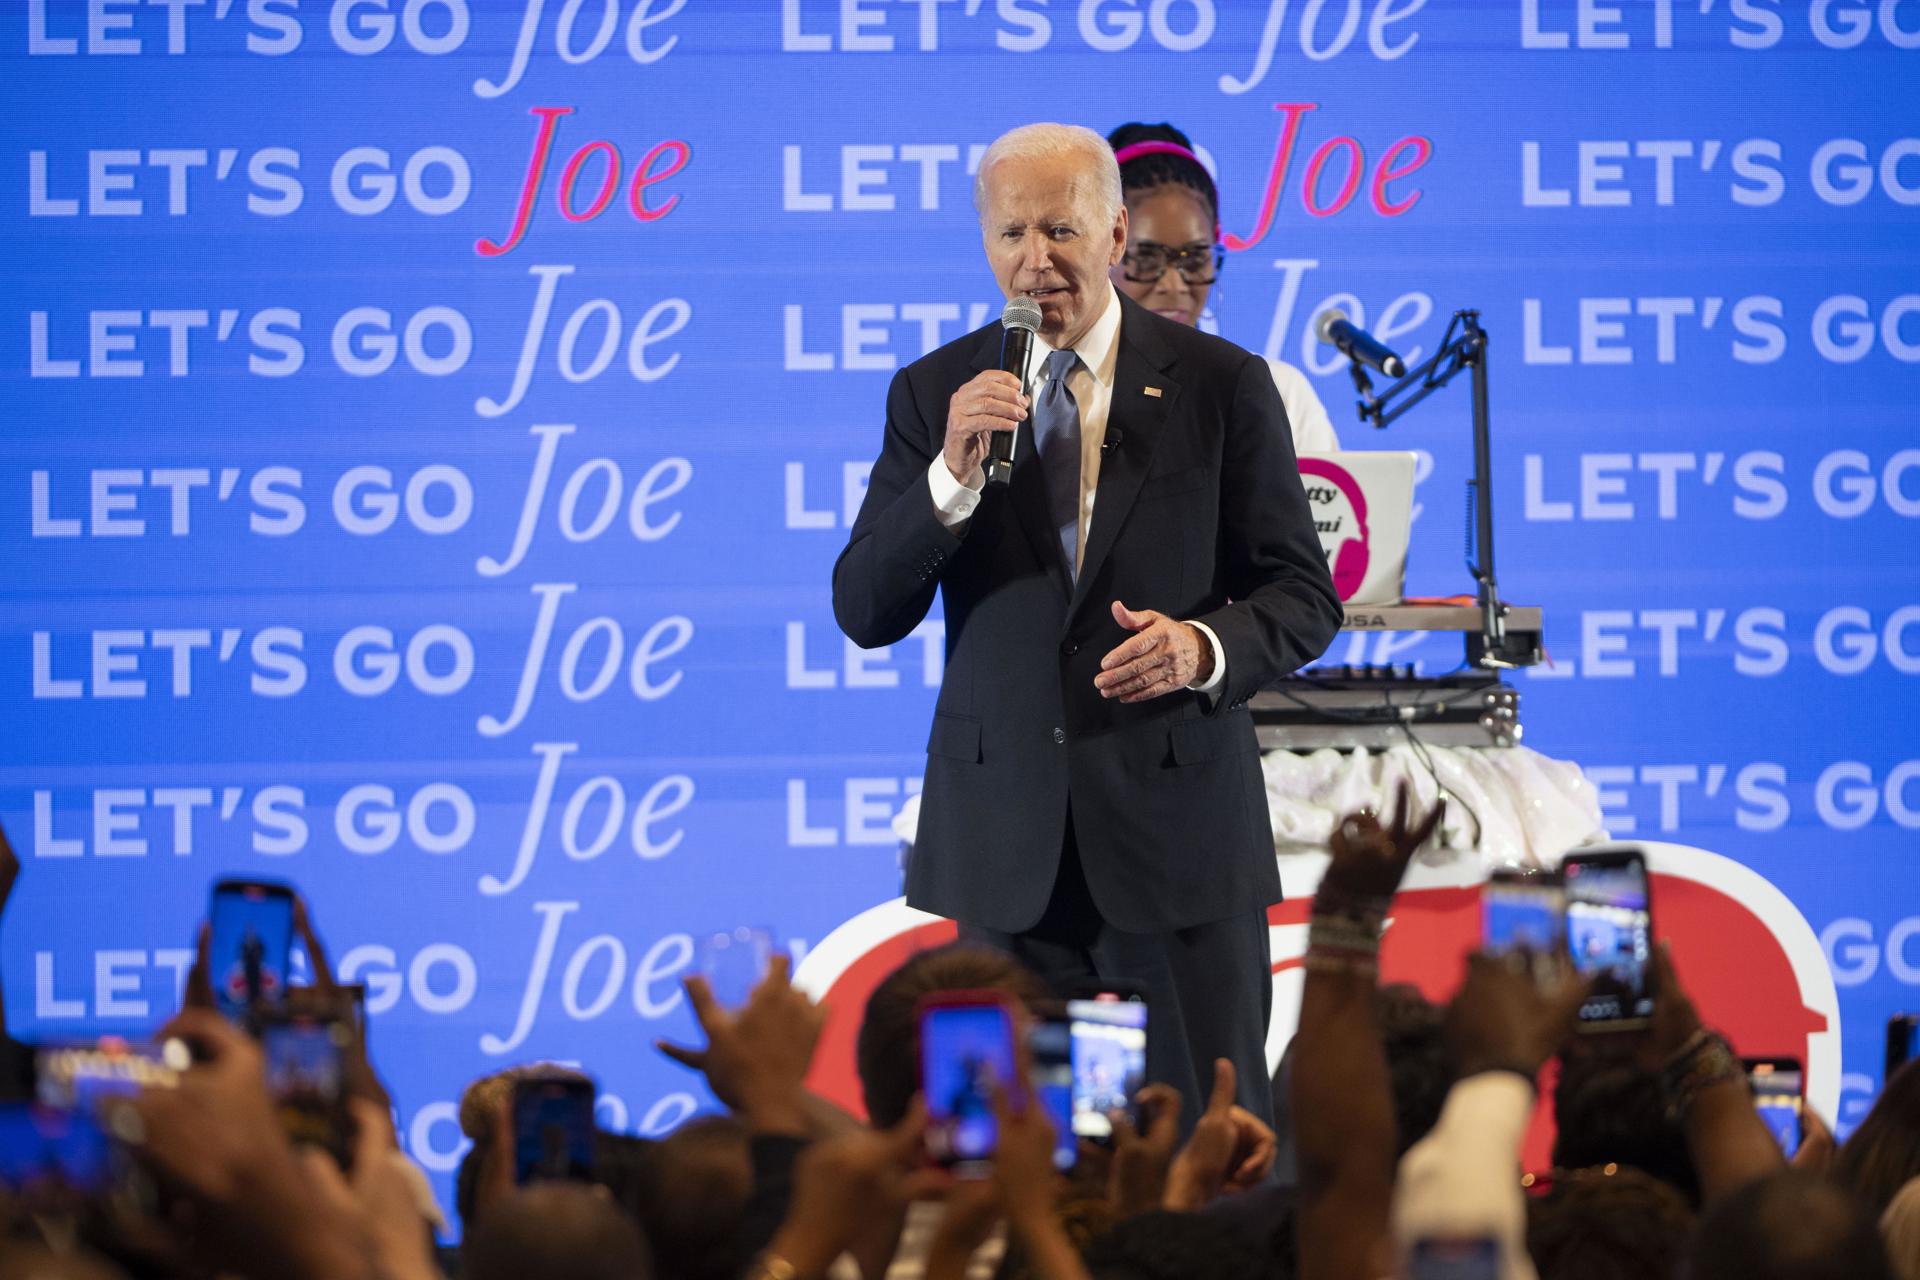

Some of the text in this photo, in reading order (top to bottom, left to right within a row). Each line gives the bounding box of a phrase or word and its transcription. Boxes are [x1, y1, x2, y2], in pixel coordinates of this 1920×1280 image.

[29, 0, 686, 98] LET'S GO Joe
[783, 0, 1425, 94] LET'S GO Joe
[30, 107, 690, 256] LET'S GO Joe
[784, 145, 986, 211] LET'
[1222, 103, 1431, 251] Joe
[1522, 139, 1783, 206] LET'S
[31, 265, 691, 417] LET'S GO Joe
[784, 304, 989, 371] LET'
[1523, 296, 1785, 364] LET'S
[32, 425, 692, 576] LET'S GO Joe
[1307, 486, 1337, 504] tty
[1524, 451, 1787, 520] LET'S
[34, 583, 693, 736] LET'S GO Joe
[786, 619, 945, 688] LET
[1526, 607, 1789, 678] ET'S
[35, 744, 694, 895] LET'S GO Joe
[1584, 762, 1790, 832] ET'S
[36, 902, 694, 1054] LET GO Joe
